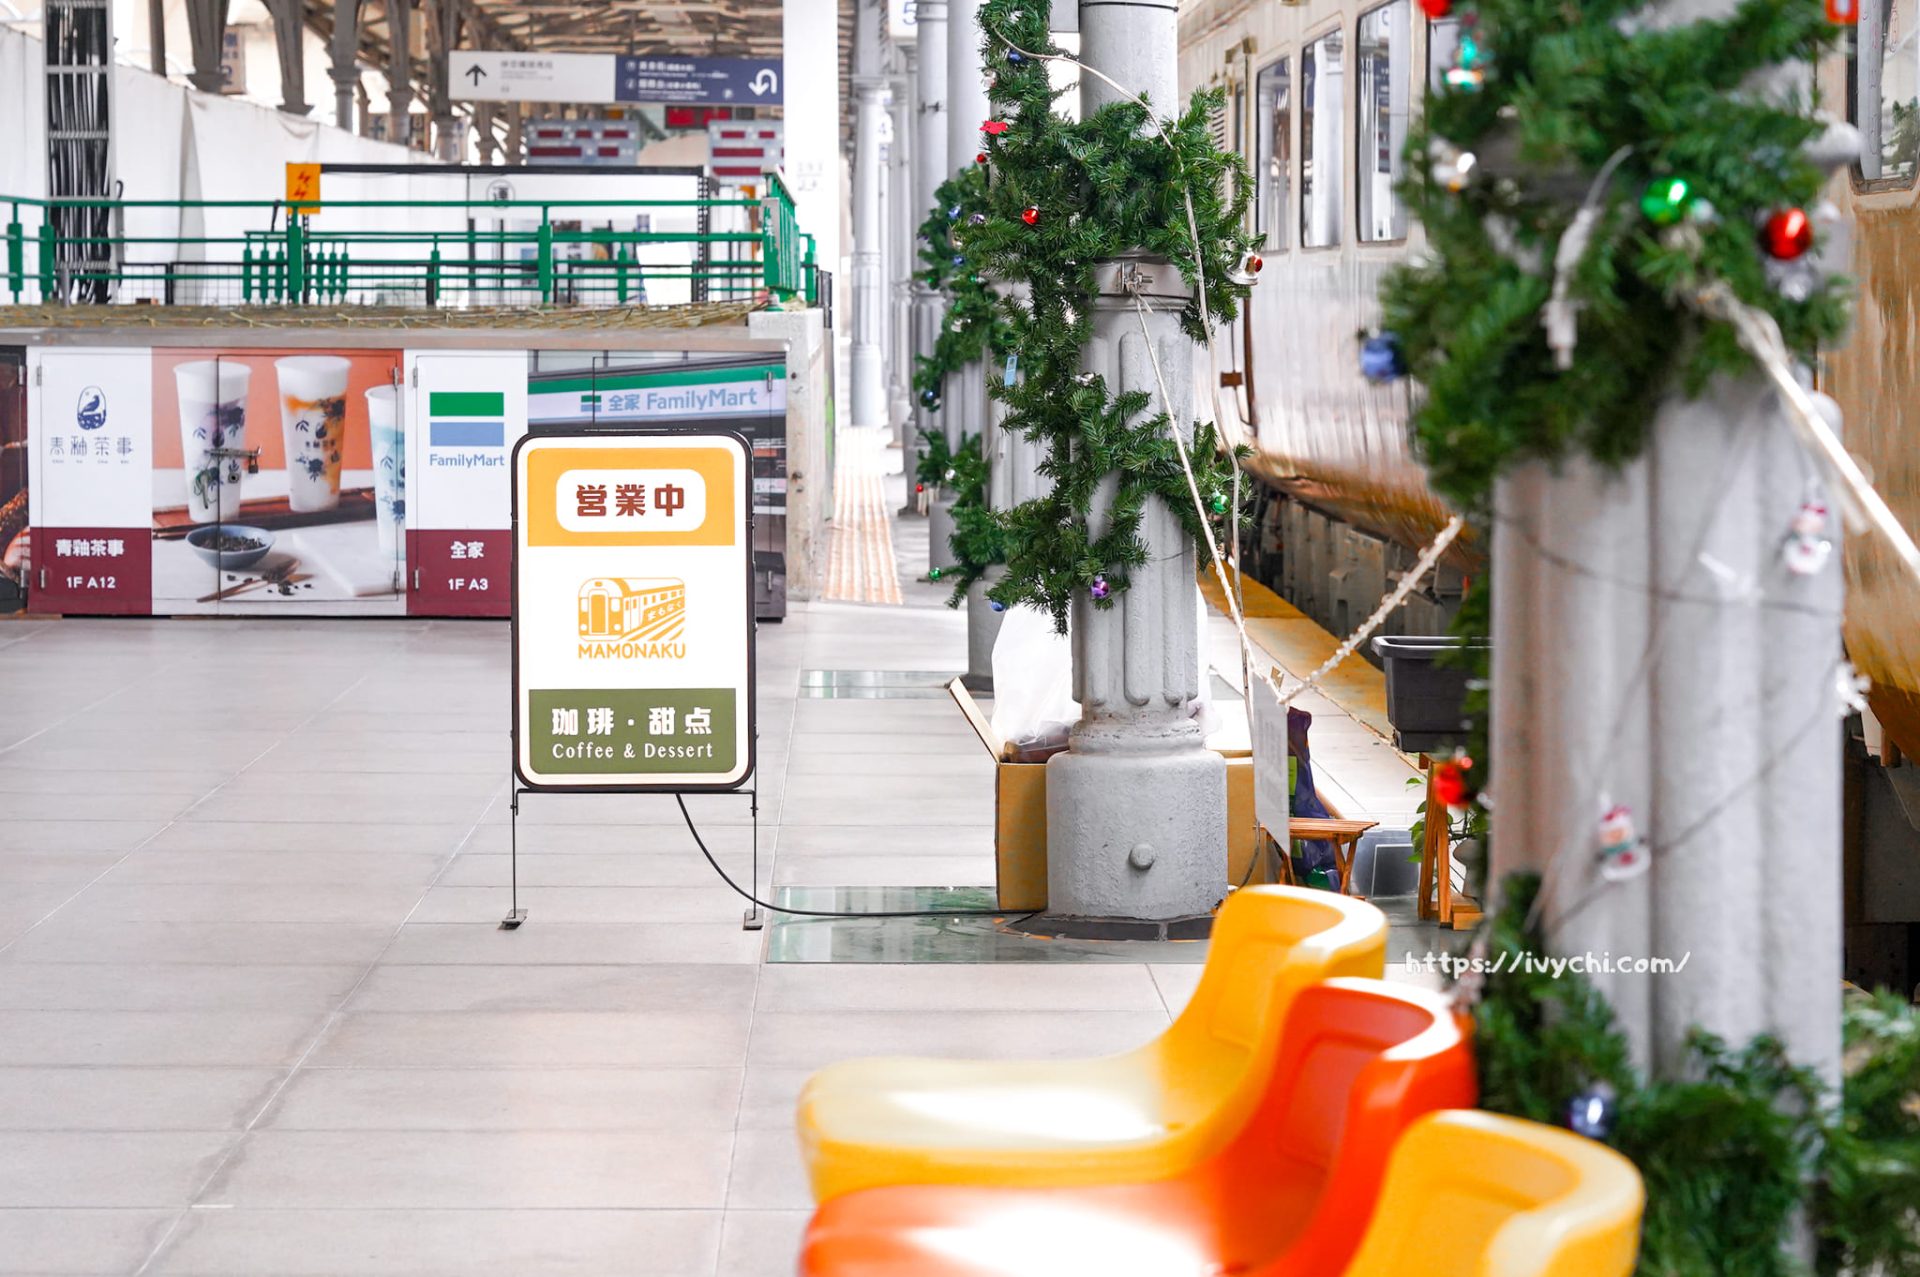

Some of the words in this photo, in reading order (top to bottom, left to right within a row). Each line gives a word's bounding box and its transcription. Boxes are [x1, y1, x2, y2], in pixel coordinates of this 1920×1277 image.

[608, 394, 641, 412] 全家
[646, 387, 758, 412] FamilyMart
[429, 453, 505, 469] FamilyMart
[576, 483, 685, 517] 営業中
[55, 538, 124, 558] 青釉茶事
[450, 541, 485, 559] 全家
[66, 576, 83, 589] 1F
[87, 576, 116, 589] A12
[448, 578, 465, 591] 1F
[469, 578, 489, 591] A3
[647, 600, 682, 621] まもなく
[578, 642, 686, 659] MAMONAKU
[552, 742, 614, 759] Coffee
[623, 743, 636, 758] &
[644, 743, 713, 758] Dessert
